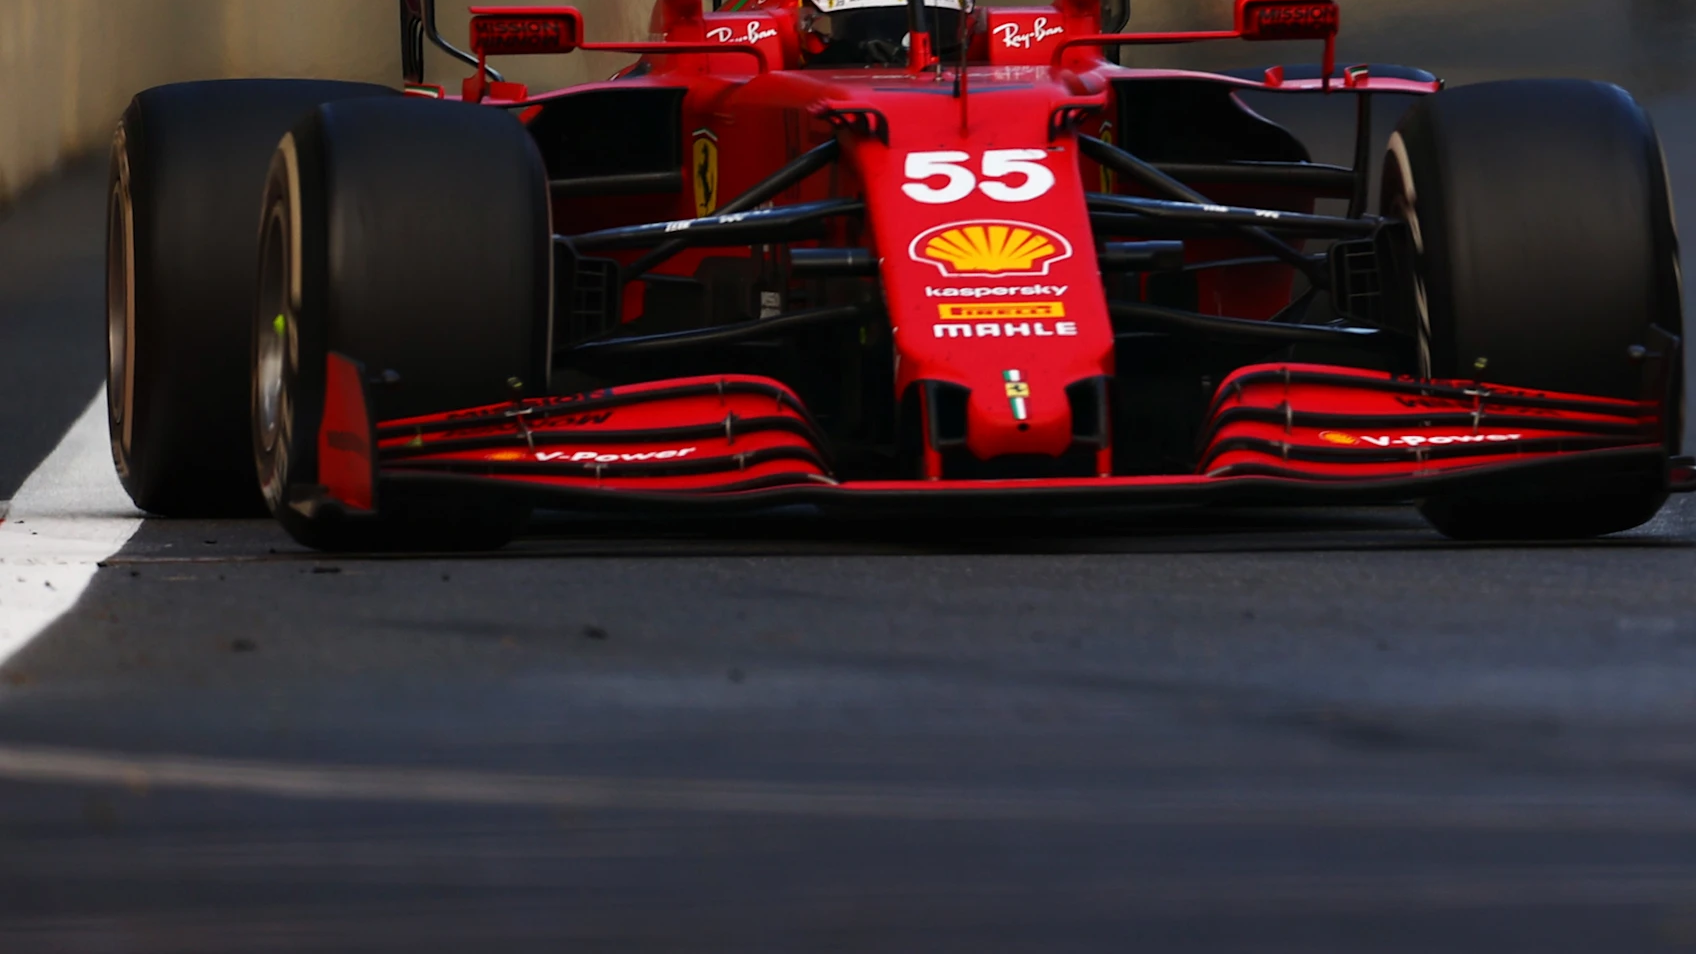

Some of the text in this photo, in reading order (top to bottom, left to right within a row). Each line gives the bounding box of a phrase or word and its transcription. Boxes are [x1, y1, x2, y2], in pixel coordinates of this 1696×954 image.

[992, 16, 1065, 49] Ray-Ban
[901, 148, 1056, 204] 55
[924, 282, 1069, 299] kaspersky
[932, 320, 1079, 338] MAHLE
[1359, 431, 1523, 448] V-Power
[534, 445, 697, 464] V-Power
